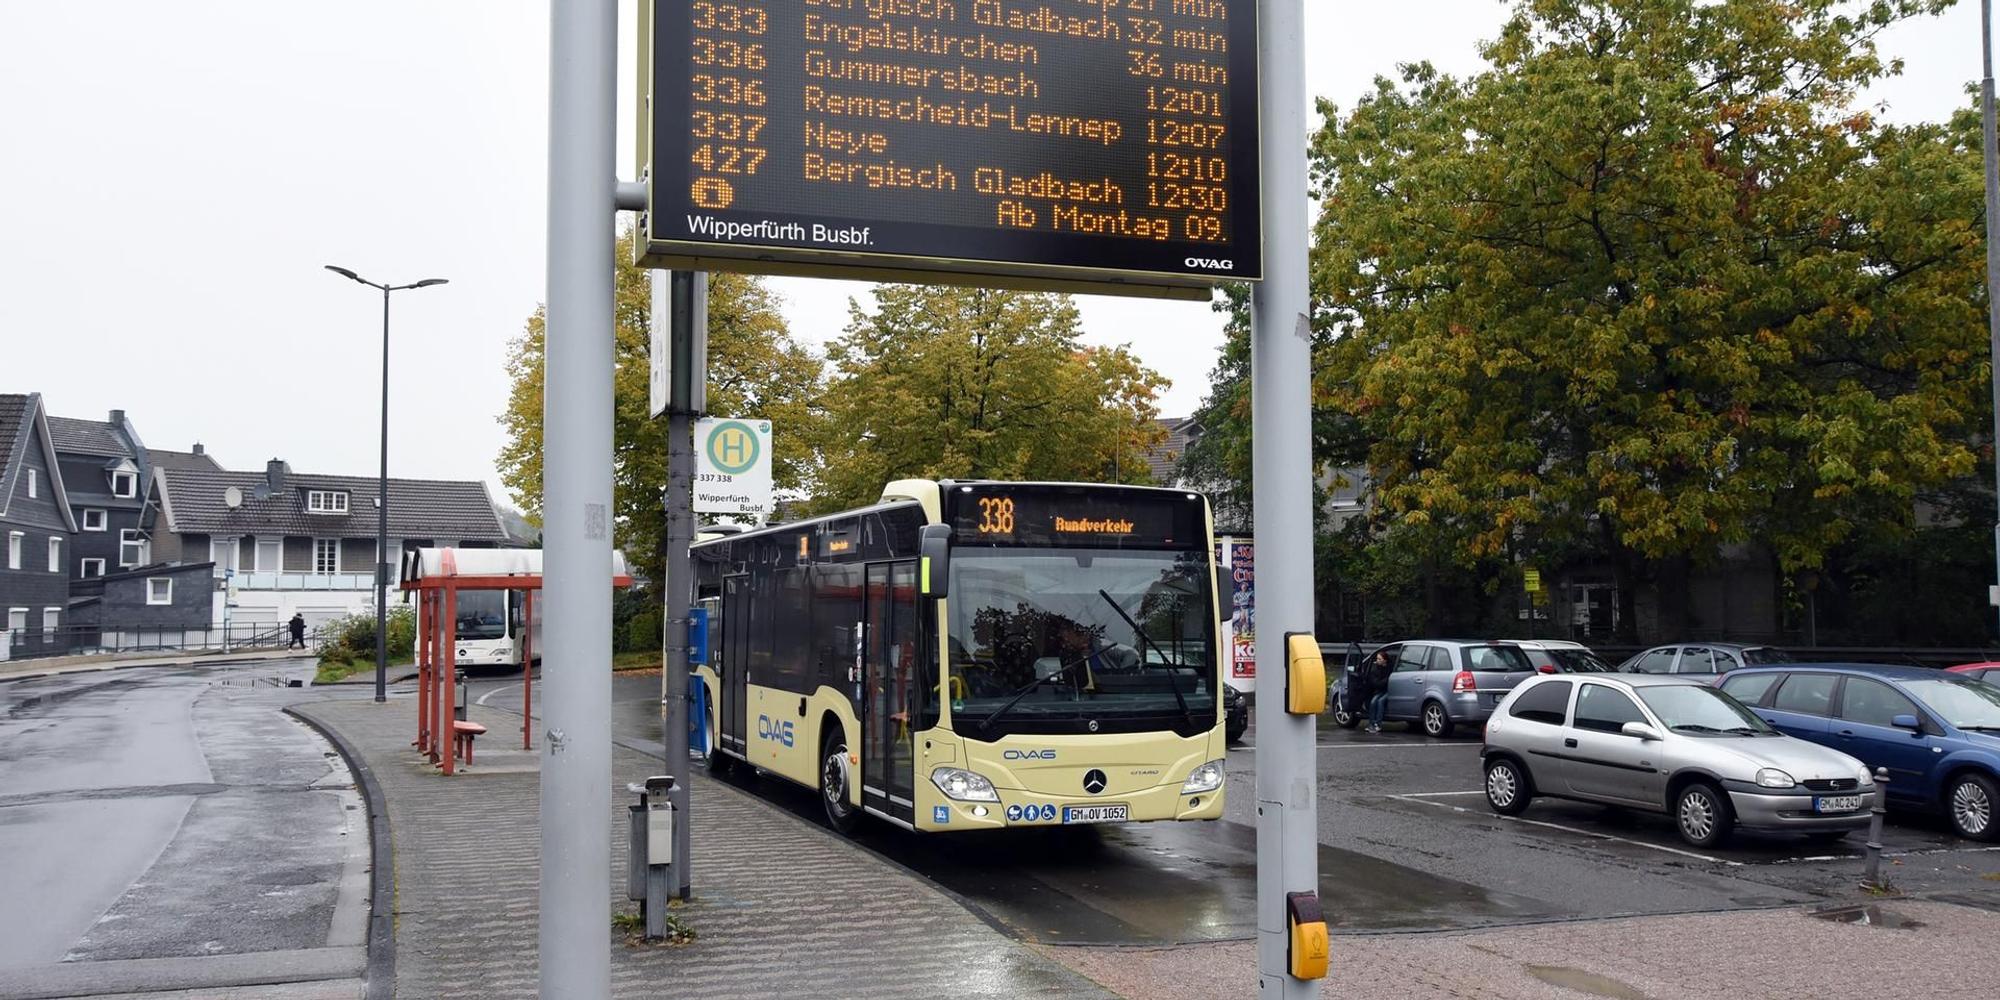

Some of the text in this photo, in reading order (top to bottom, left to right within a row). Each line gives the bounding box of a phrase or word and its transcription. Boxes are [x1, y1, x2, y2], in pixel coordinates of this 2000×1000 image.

[692, 2, 1226, 85] 333 Engelskirchen 36 min
[805, 0, 1226, 53] gisch Gladbach 32 min
[692, 37, 1222, 117] 336 Gummersbach 12:01
[692, 74, 1226, 149] 336 Remscheid-Lennep 12:07
[692, 111, 1226, 182] 337 Neye 12:10
[692, 144, 1227, 212] 427 Bergisch Gladbach 12:30
[687, 214, 875, 246] Wipperfürth Busbf.
[998, 200, 1228, 242] Ab Montag 09.
[1184, 256, 1234, 271] OVAG
[699, 473, 733, 484] 337 338
[698, 493, 766, 513] Wipperfürth Busbf.
[978, 497, 1134, 534] 338 Rundverkehr
[758, 714, 794, 748] OVAG
[1003, 749, 1057, 760] OVAG
[1071, 809, 1084, 820] GM
[1102, 807, 1125, 819] 1052
